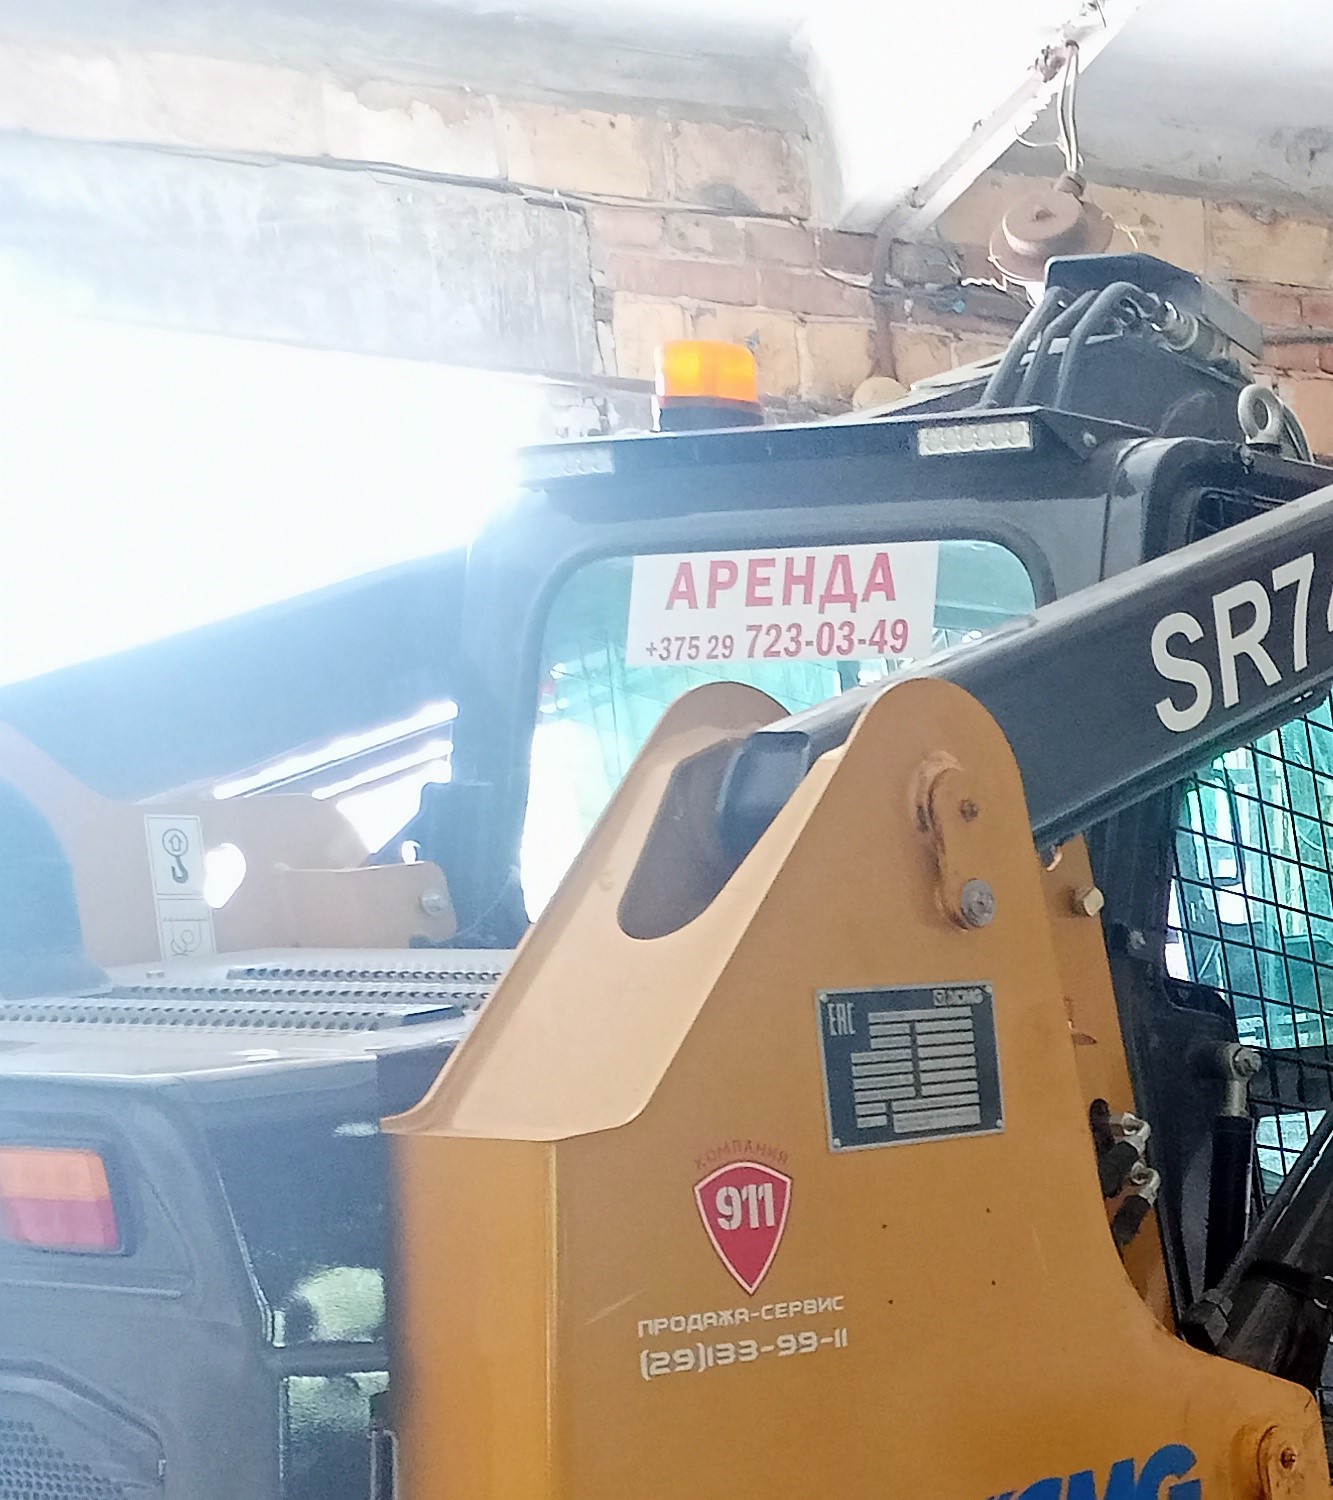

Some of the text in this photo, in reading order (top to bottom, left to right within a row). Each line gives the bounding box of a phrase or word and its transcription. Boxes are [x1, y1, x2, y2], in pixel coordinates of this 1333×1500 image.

[664, 552, 896, 614] АРЕНДА
[645, 618, 909, 661] +375 29 723-03-49
[716, 1183, 776, 1231] 911
[638, 1296, 845, 1338] ПРОДАЖА-СЕРВИС
[640, 1328, 849, 1381] (29)133-99-11
